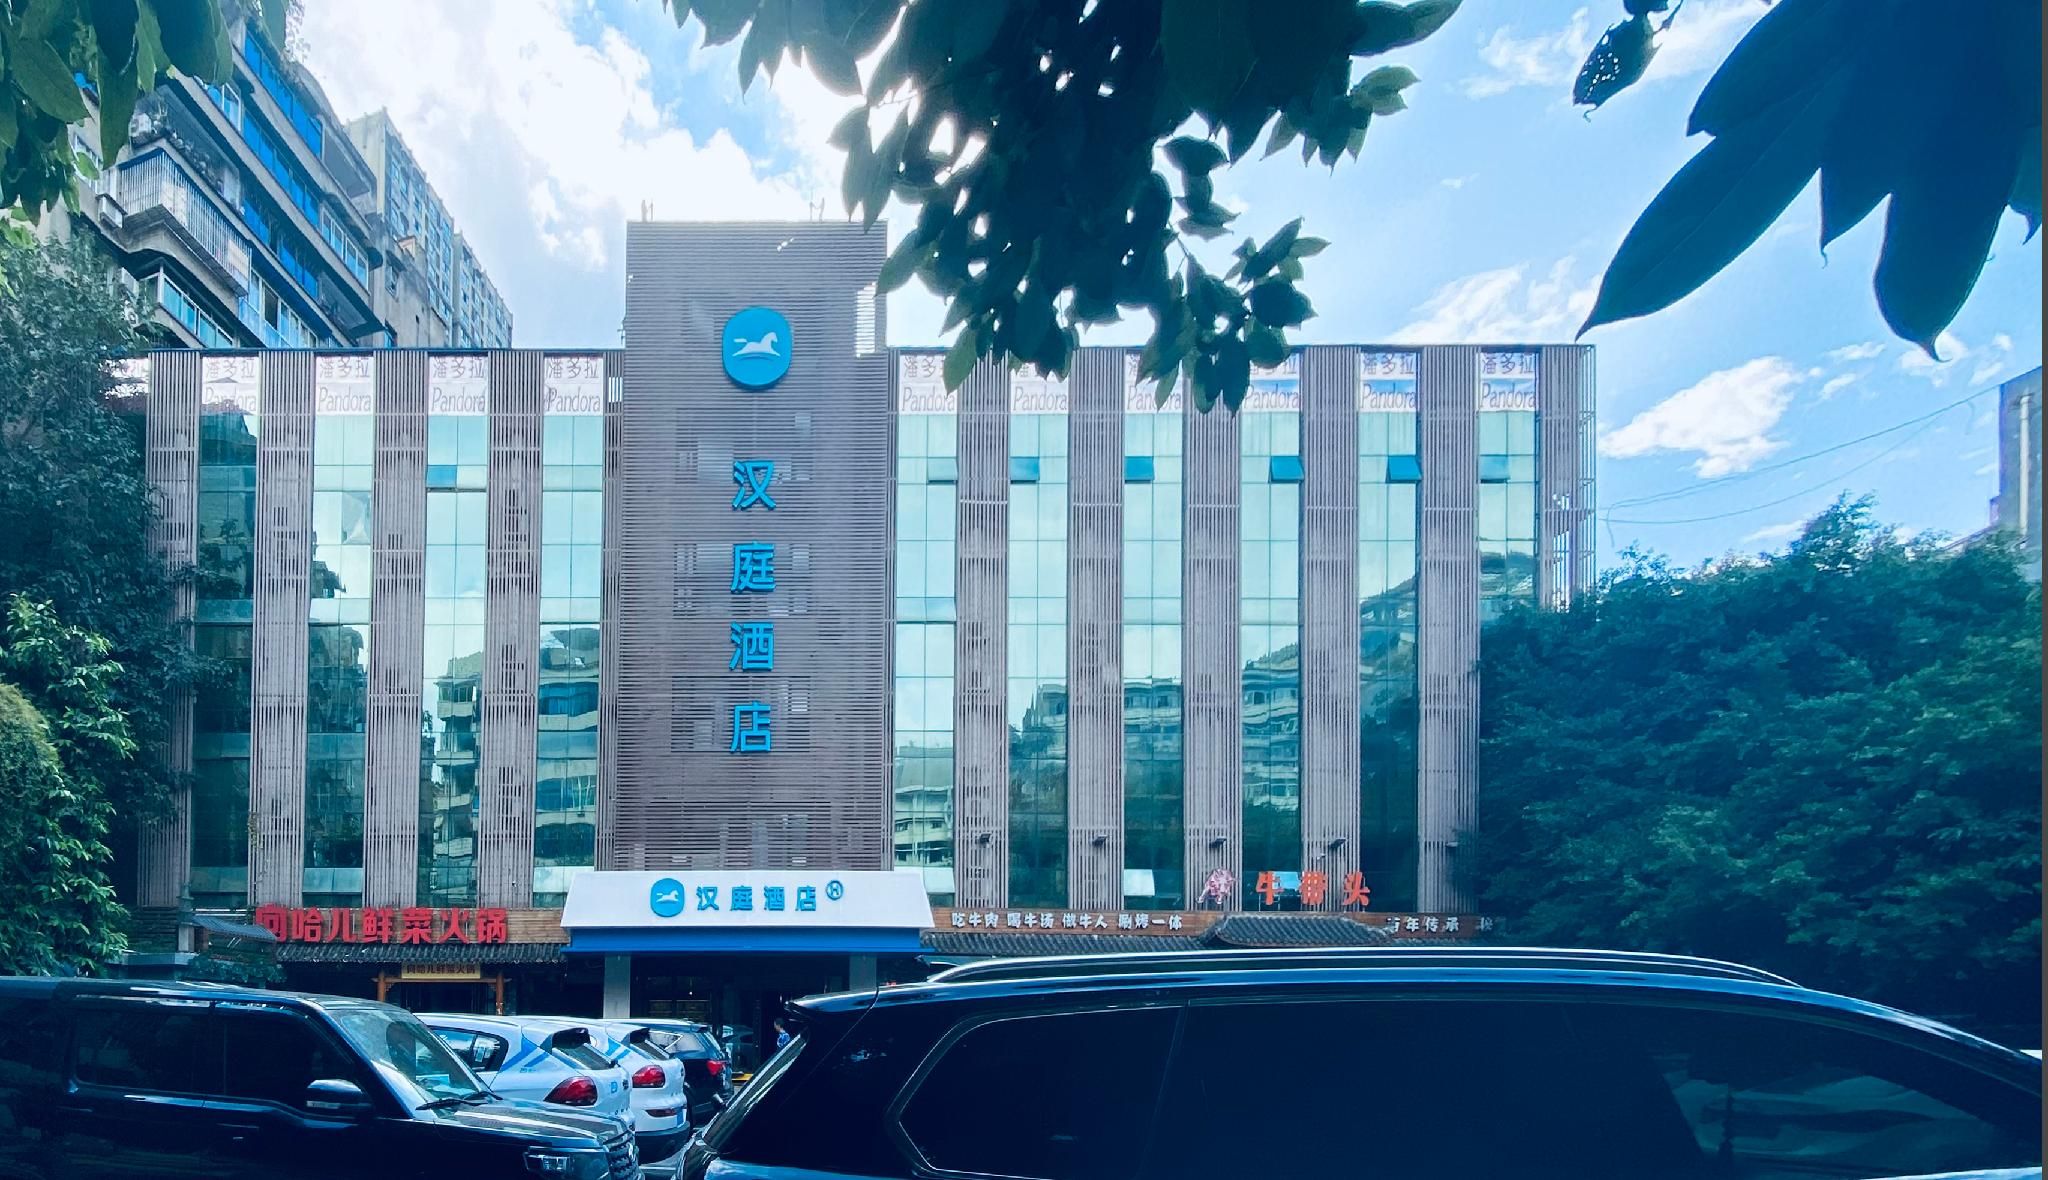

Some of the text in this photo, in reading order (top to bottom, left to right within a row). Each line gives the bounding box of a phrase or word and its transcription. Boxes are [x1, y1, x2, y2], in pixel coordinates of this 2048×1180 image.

[319, 356, 371, 379] 潘多拉
[433, 356, 485, 379] 潘多拉
[545, 356, 600, 379] 潘多拉
[903, 355, 944, 378] 潘多
[1362, 353, 1414, 375] 潘多拉
[1482, 352, 1534, 375] 潘多拉
[317, 386, 372, 413] Pandora
[432, 386, 487, 413] Pandora
[545, 386, 601, 412] Pandora
[901, 386, 956, 412] Pandora
[1013, 386, 1068, 411] Pandora
[1127, 385, 1182, 410] Panra
[1243, 383, 1300, 409] Pandora
[1361, 382, 1416, 409] Pandora
[1480, 381, 1537, 408] Pandora
[729, 459, 777, 753] 汉庭酒店
[695, 884, 817, 912] 汉庭酒店
[255, 903, 508, 944] 向哈儿鲜菜火锅
[951, 912, 999, 929] 吃牛肉
[1007, 912, 1055, 929] 喝牛汤
[1118, 912, 1183, 931] 涮烤一体
